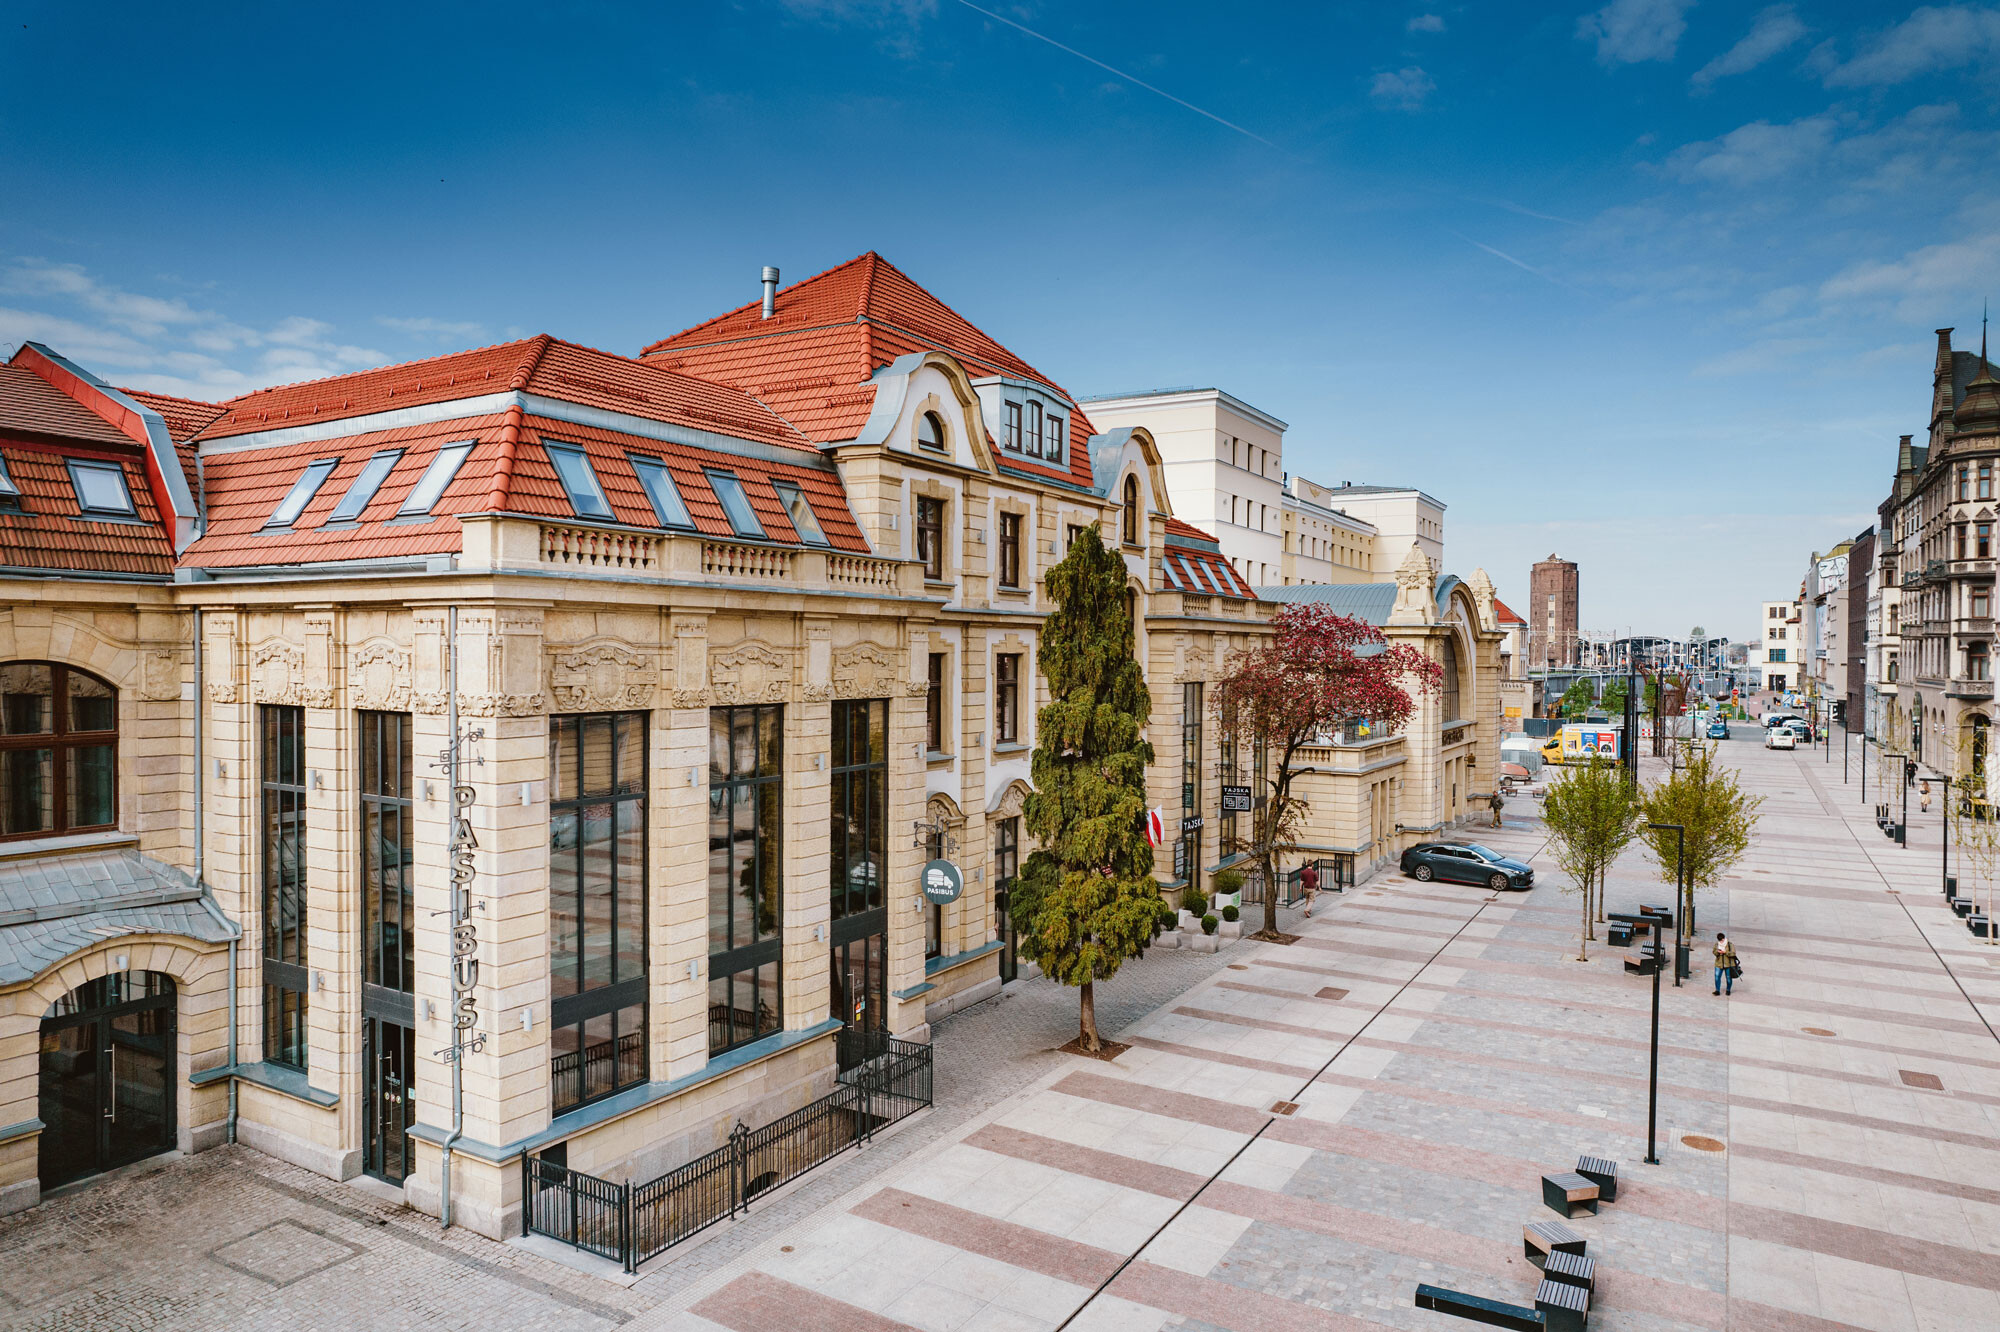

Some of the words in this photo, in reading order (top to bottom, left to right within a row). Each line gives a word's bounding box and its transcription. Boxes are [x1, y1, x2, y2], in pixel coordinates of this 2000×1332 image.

[1183, 817, 1204, 831] TAJSKA
[927, 887, 954, 896] PASIBUS
[449, 785, 479, 1031] PASIBUS
